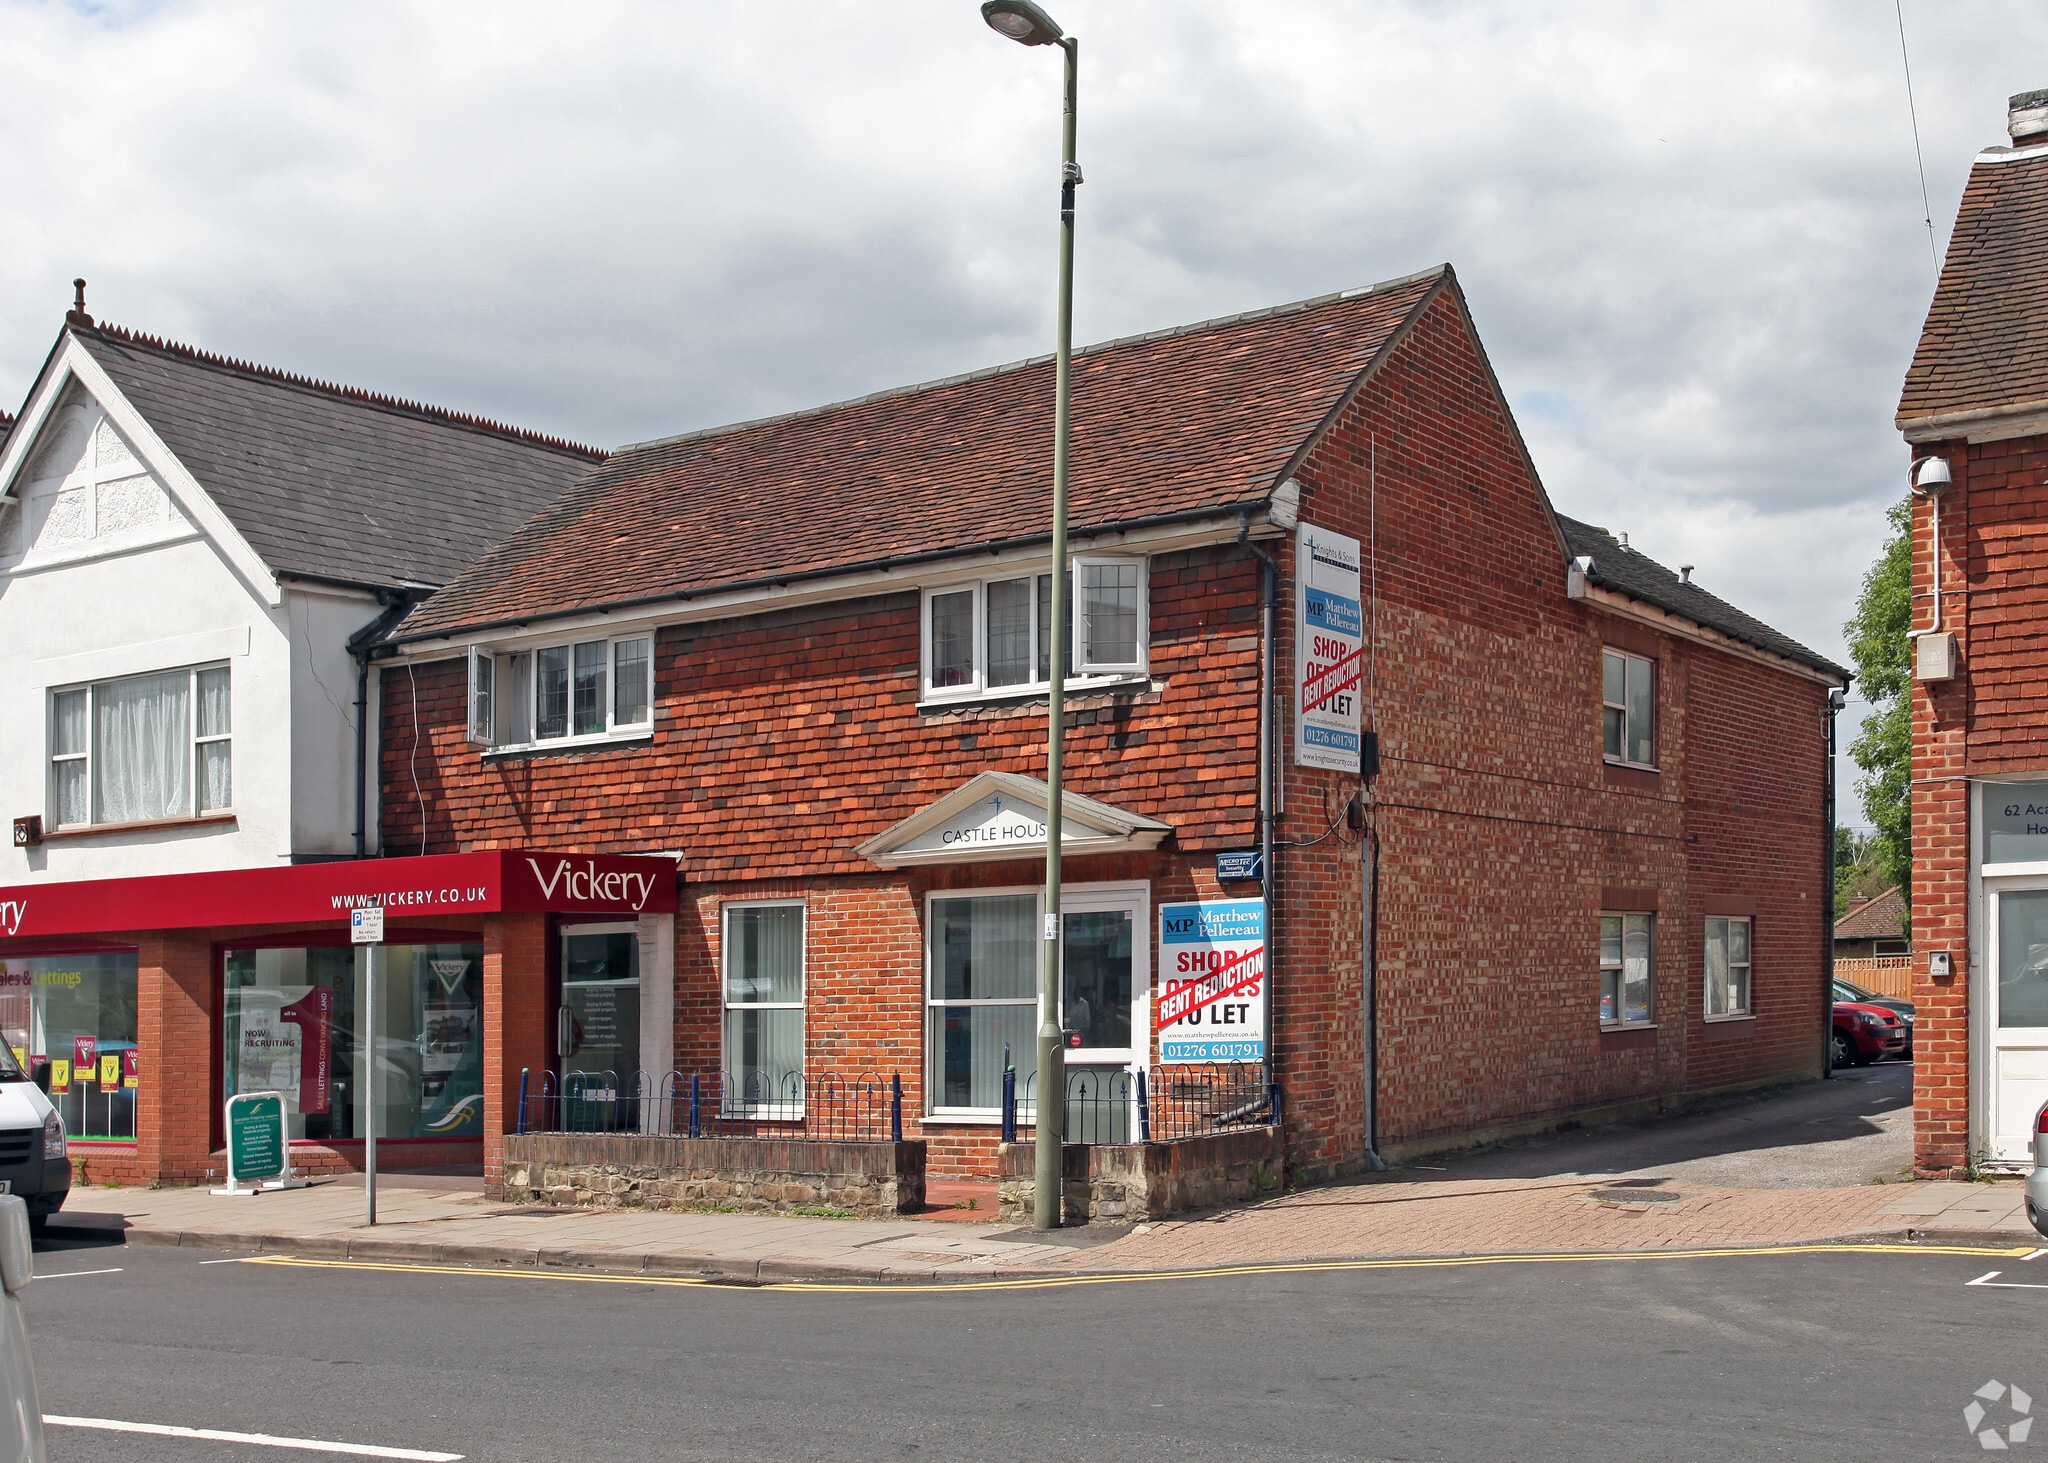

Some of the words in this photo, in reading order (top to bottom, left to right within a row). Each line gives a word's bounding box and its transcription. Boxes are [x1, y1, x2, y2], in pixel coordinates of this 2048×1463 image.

[1316, 544, 1337, 560] Knights
[1338, 550, 1342, 560] &
[1342, 552, 1355, 564] Sons
[1307, 600, 1324, 616] MP
[1325, 598, 1358, 618] Matthew
[1326, 612, 1358, 632] Pellereau
[1304, 678, 1322, 708] RENT
[1324, 654, 1360, 694] REDUCTION
[1332, 694, 1352, 716] LET
[1306, 729, 1329, 744] 01276
[1332, 733, 1356, 748] 601791
[2004, 804, 2020, 816] 62
[942, 826, 996, 844] CASTLE
[1002, 822, 1047, 839] HOUS
[525, 858, 656, 911] Vickery
[331, 887, 487, 908] WWWVICKERY.CO.UK
[0, 900, 27, 936] ry
[1166, 918, 1194, 933] MP
[1198, 909, 1261, 923] Matthew
[1198, 924, 1260, 938] Pellereau
[435, 963, 465, 972] Vickery
[23, 970, 31, 986] &
[34, 970, 81, 989] Lettings
[1160, 988, 1192, 1022] RENT
[1194, 952, 1264, 1005] REDUCTION
[1211, 1004, 1250, 1024] LET
[1168, 1031, 1259, 1040] www.matthewpellereau.co.uk
[1168, 1044, 1207, 1057] 01276
[1211, 1043, 1259, 1057] 601791
